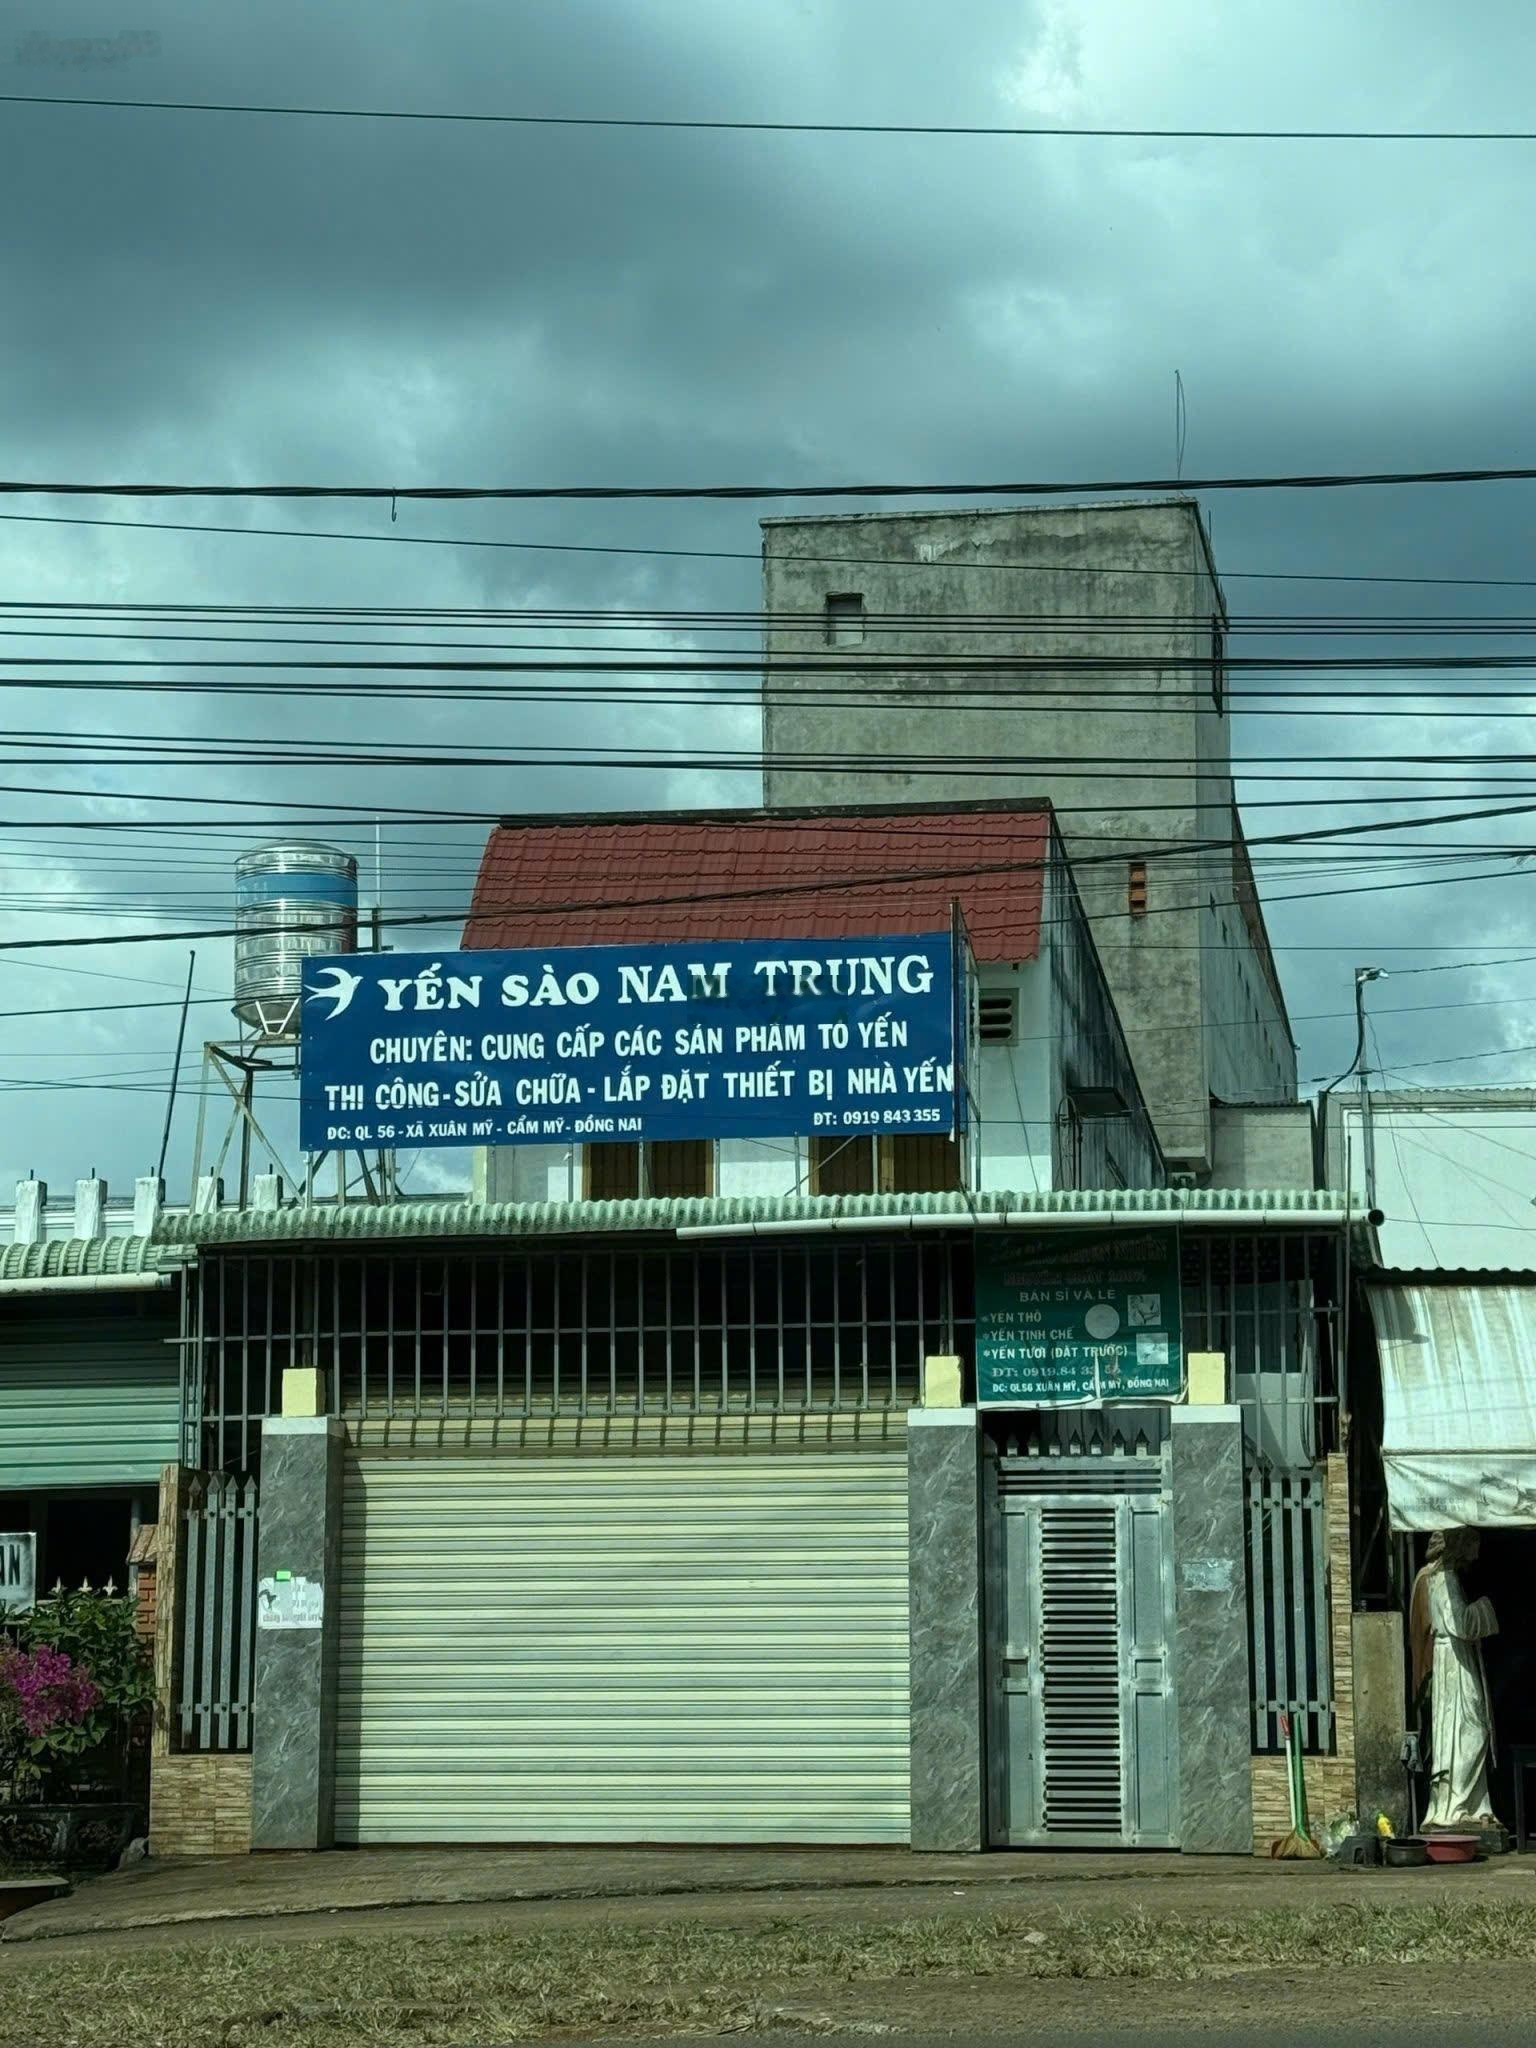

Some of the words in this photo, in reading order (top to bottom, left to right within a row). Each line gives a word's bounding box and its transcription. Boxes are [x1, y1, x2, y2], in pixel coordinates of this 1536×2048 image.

[378, 963, 482, 1011] YẾN
[502, 965, 599, 1006] SÀO
[618, 963, 731, 1003] NAM
[754, 955, 933, 995] TRUNG
[370, 1030, 472, 1064] CHUYÊN:
[481, 1033, 544, 1060] CUNG
[557, 1024, 604, 1057] CẤP
[615, 1025, 661, 1056] CÁC
[858, 1012, 907, 1048] YẾN
[325, 1085, 363, 1110] THI
[516, 1073, 580, 1104] CHỮA
[605, 1065, 650, 1101] LẮP
[661, 1069, 709, 1103] ĐẶT
[723, 1061, 795, 1097] THIẾT
[809, 1070, 832, 1100] BỊ
[848, 1062, 897, 1094] NHÀ
[903, 1057, 953, 1093] YẾN
[328, 1127, 350, 1139] ĐC:
[355, 1126, 372, 1140] QL
[378, 1125, 394, 1138] 56
[406, 1121, 423, 1137] XÃ
[429, 1121, 466, 1136] XUÂN
[473, 1119, 493, 1135] MỸ
[508, 1115, 538, 1134] CẨM
[544, 1118, 564, 1133] MỸ
[619, 1118, 641, 1131] NAI
[814, 1112, 837, 1125] ĐT:
[844, 1111, 879, 1124] 0919
[884, 1110, 910, 1123] 843
[914, 1109, 940, 1121] 355
[991, 1343, 1015, 1360] YẾN
